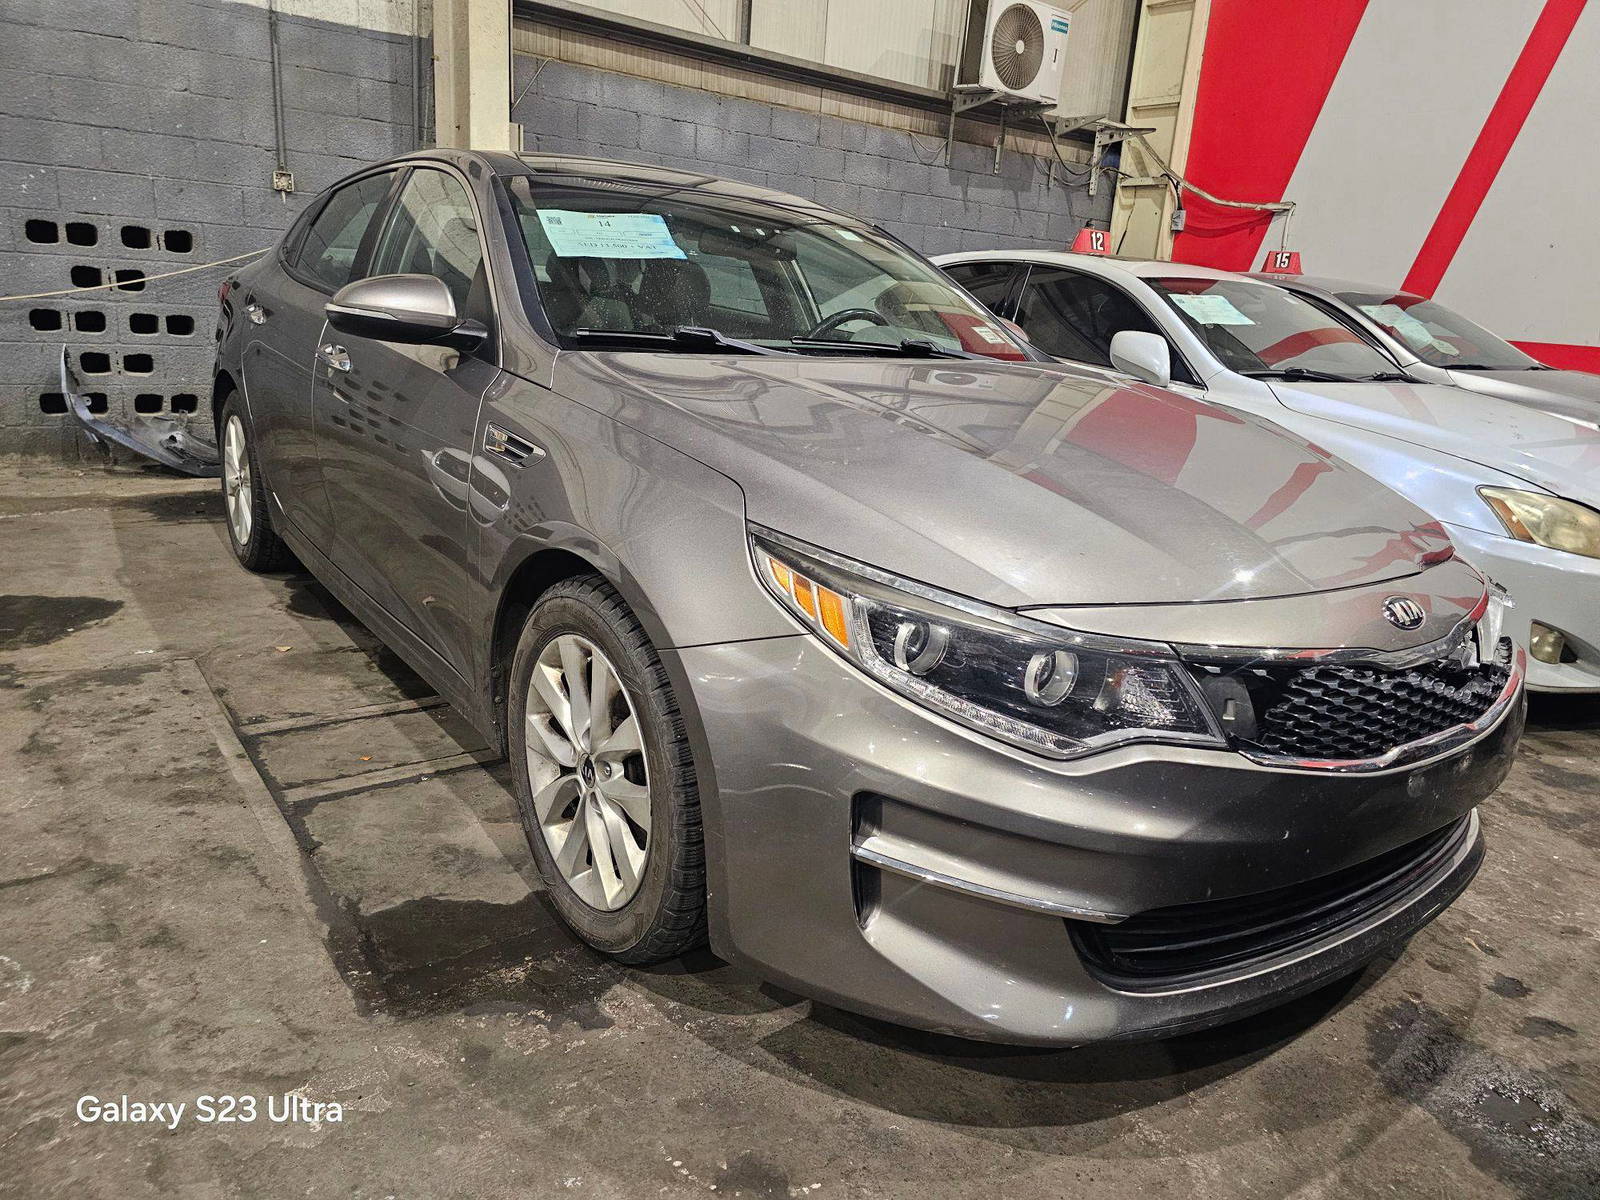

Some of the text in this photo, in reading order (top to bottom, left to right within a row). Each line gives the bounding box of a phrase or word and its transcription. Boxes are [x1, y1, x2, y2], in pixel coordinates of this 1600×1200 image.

[598, 220, 611, 228] 14
[1091, 231, 1104, 251] 12
[1275, 252, 1290, 268] 15
